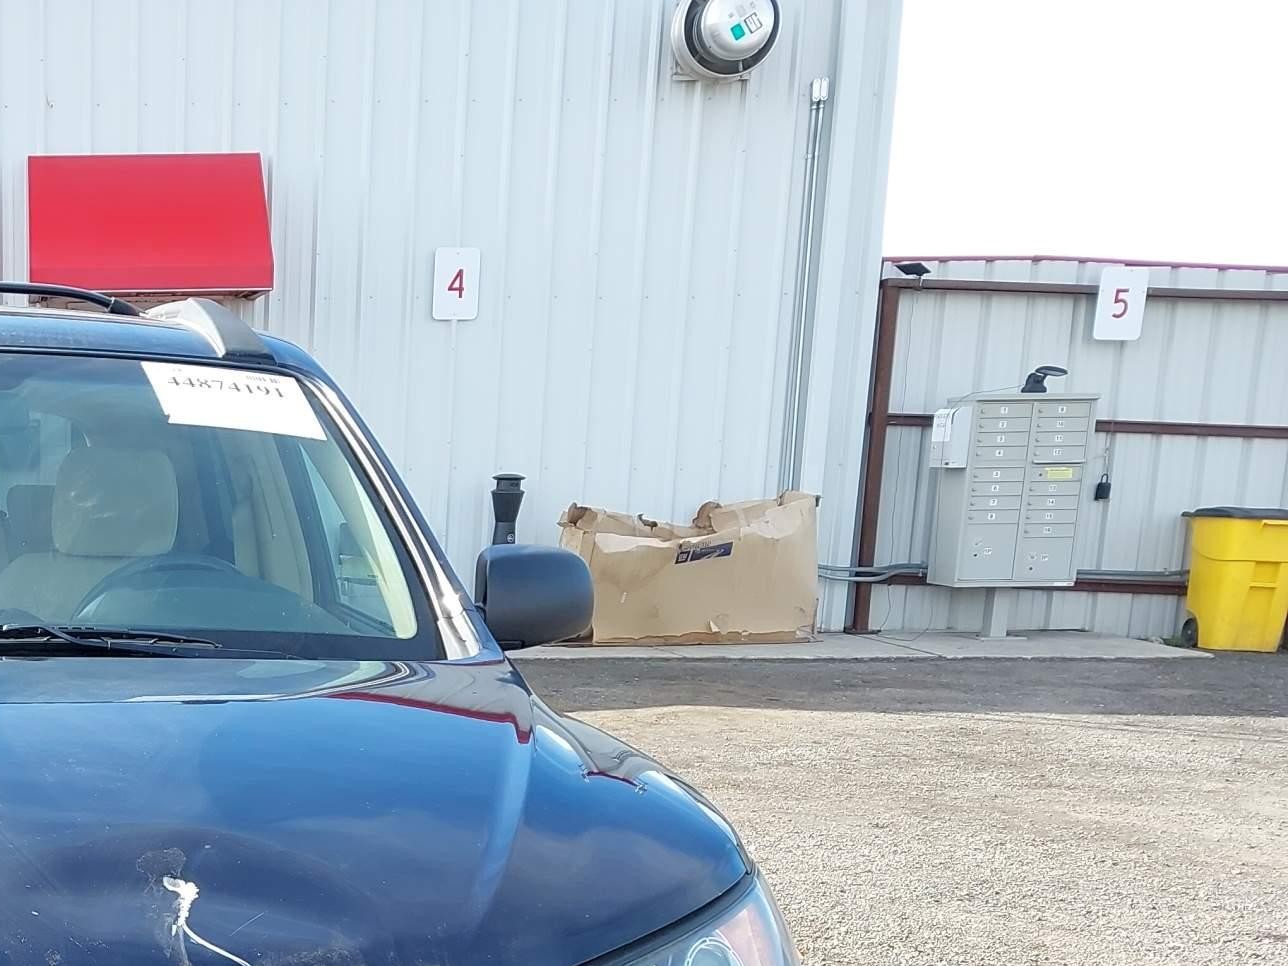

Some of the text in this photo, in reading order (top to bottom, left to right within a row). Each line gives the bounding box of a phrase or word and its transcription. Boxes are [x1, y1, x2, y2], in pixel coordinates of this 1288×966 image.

[447, 268, 465, 299] 4
[1111, 288, 1130, 319] 5
[167, 376, 283, 398] 44874191
